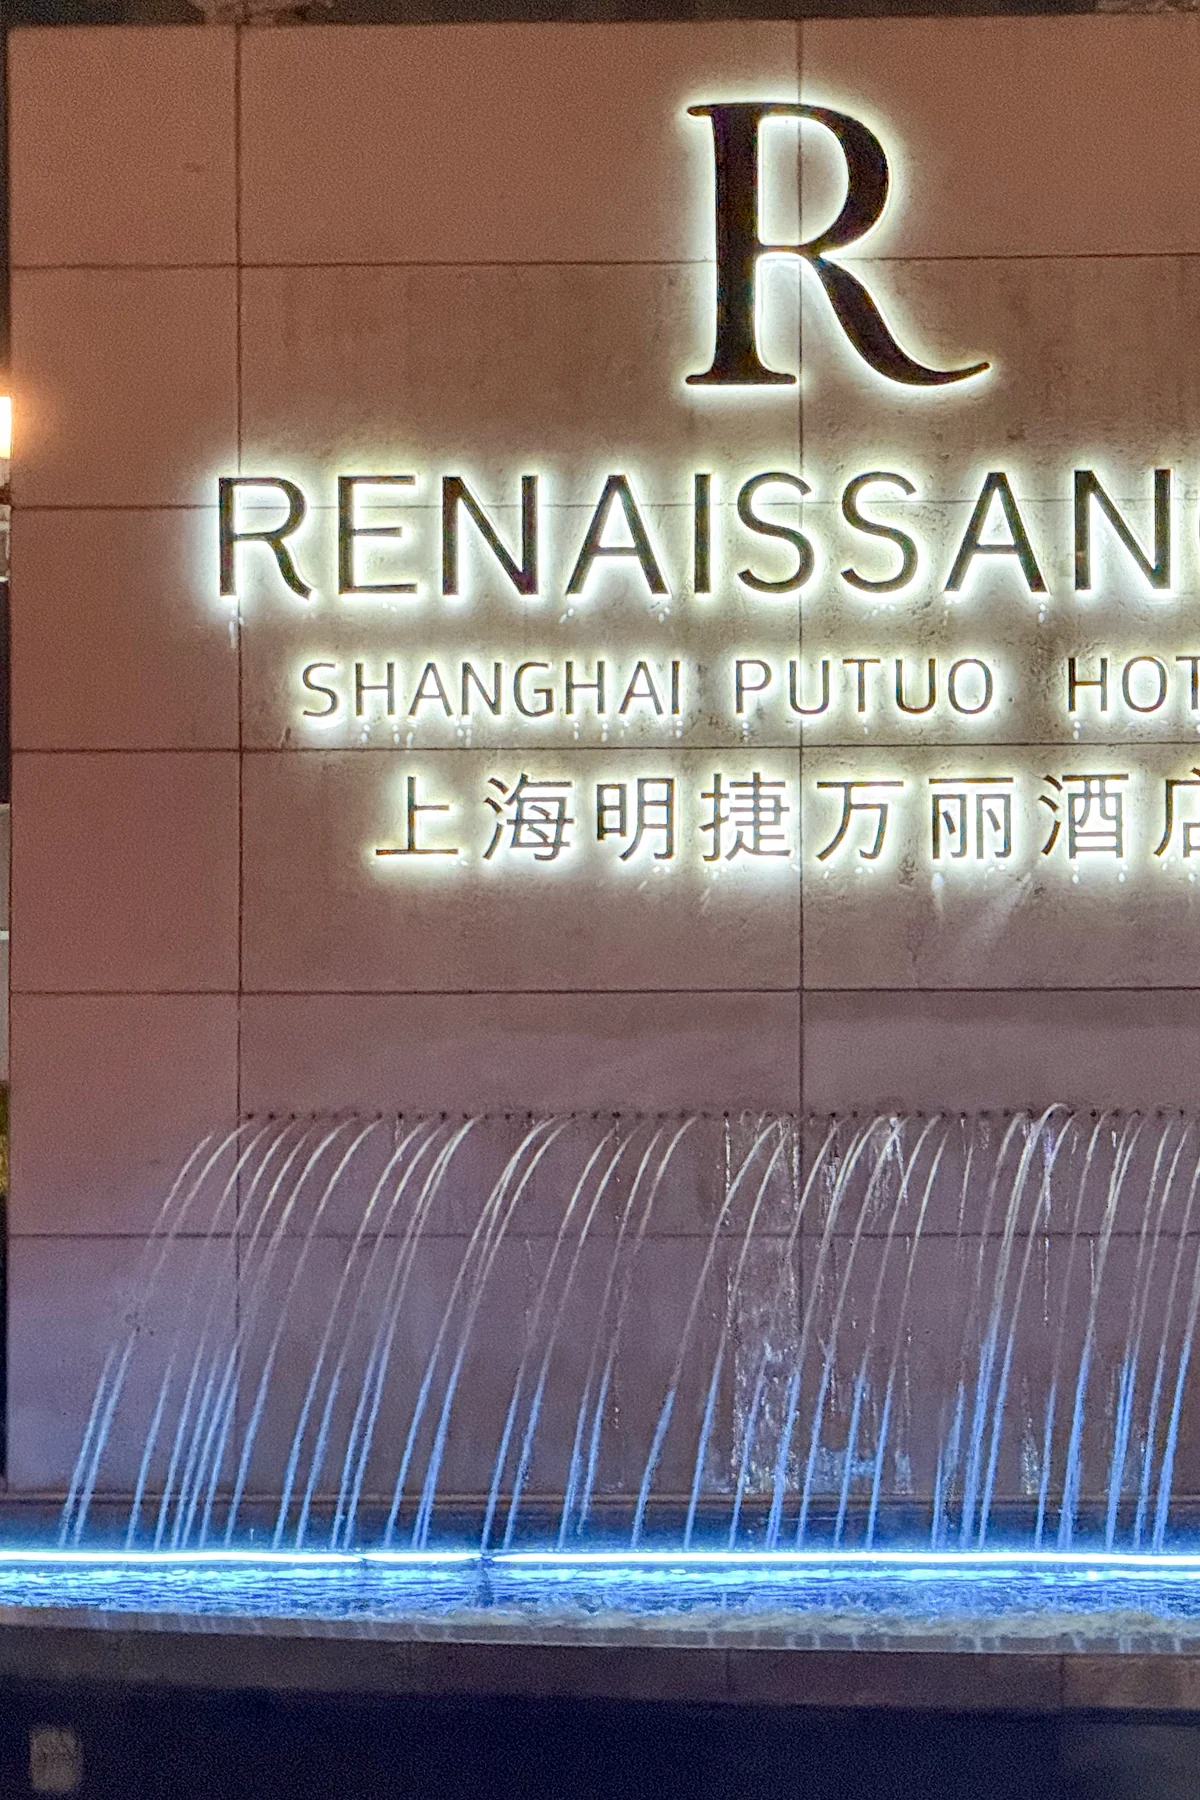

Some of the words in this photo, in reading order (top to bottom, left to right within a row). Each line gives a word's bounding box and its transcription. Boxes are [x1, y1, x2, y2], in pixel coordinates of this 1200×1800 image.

[685, 101, 990, 386] R
[301, 659, 682, 718] SHANGHAI
[735, 658, 994, 716] PUTUO
